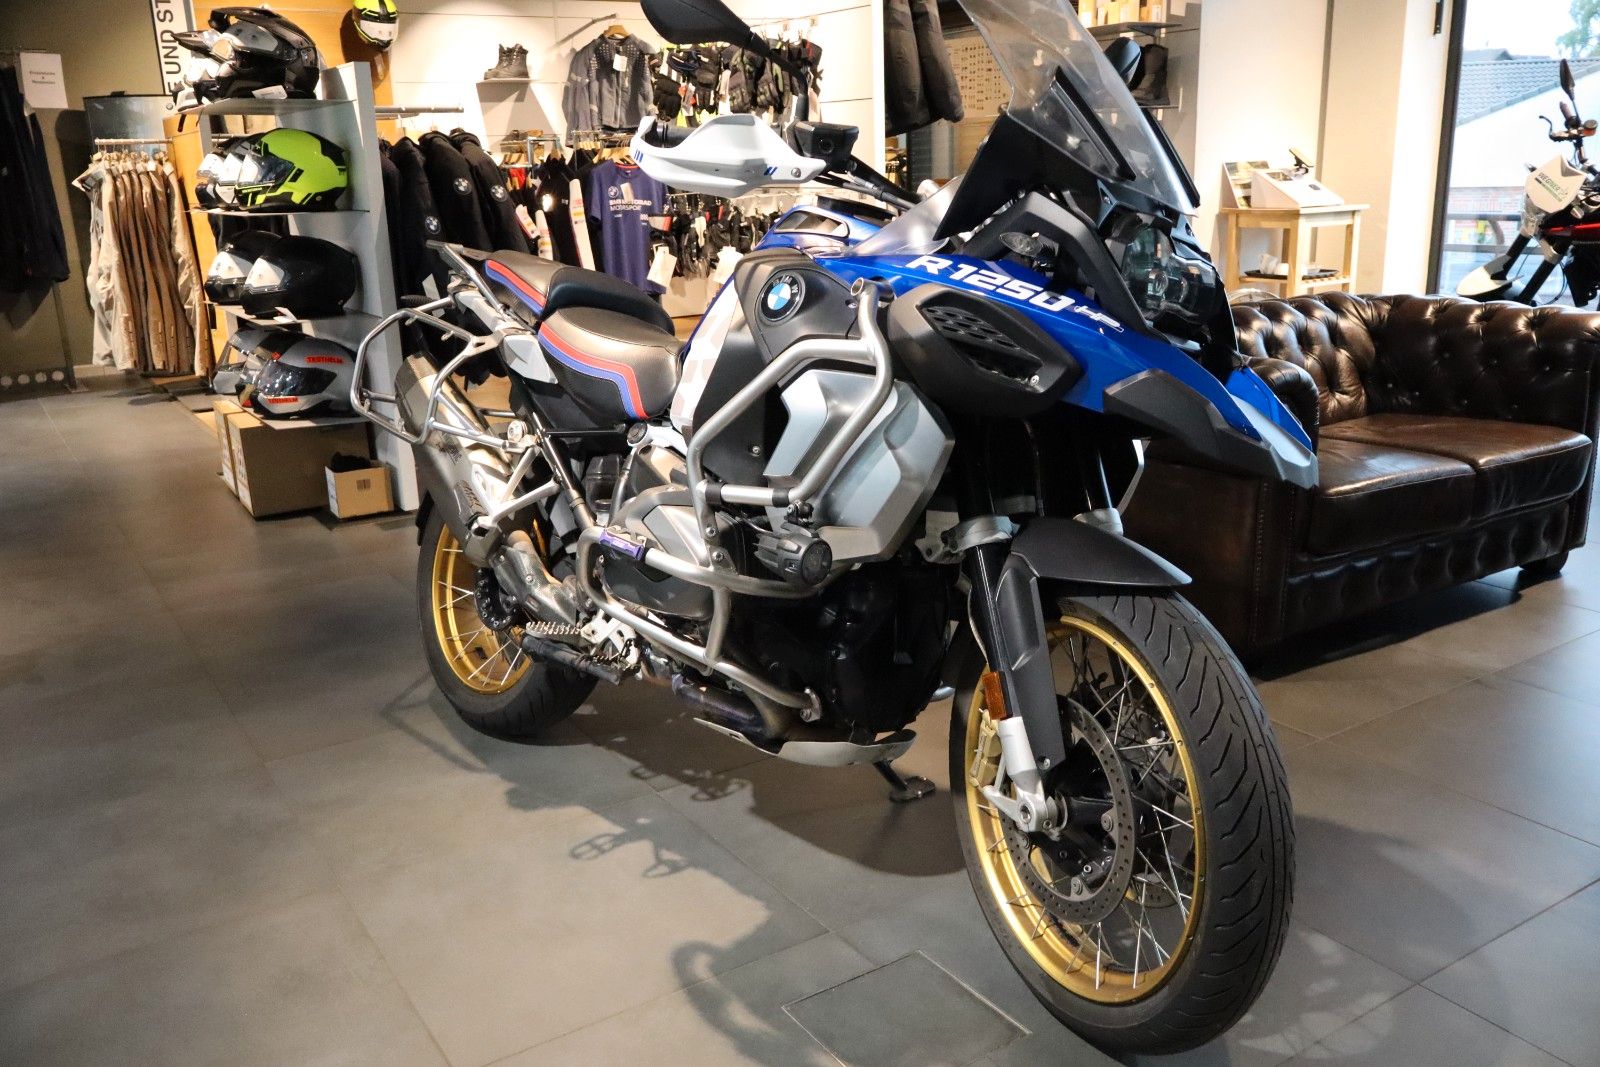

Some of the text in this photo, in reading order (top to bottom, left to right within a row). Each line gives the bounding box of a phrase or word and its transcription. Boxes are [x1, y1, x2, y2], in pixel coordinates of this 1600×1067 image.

[160, 29, 182, 75] UND
[905, 255, 953, 275] R
[949, 263, 1076, 313] 1250
